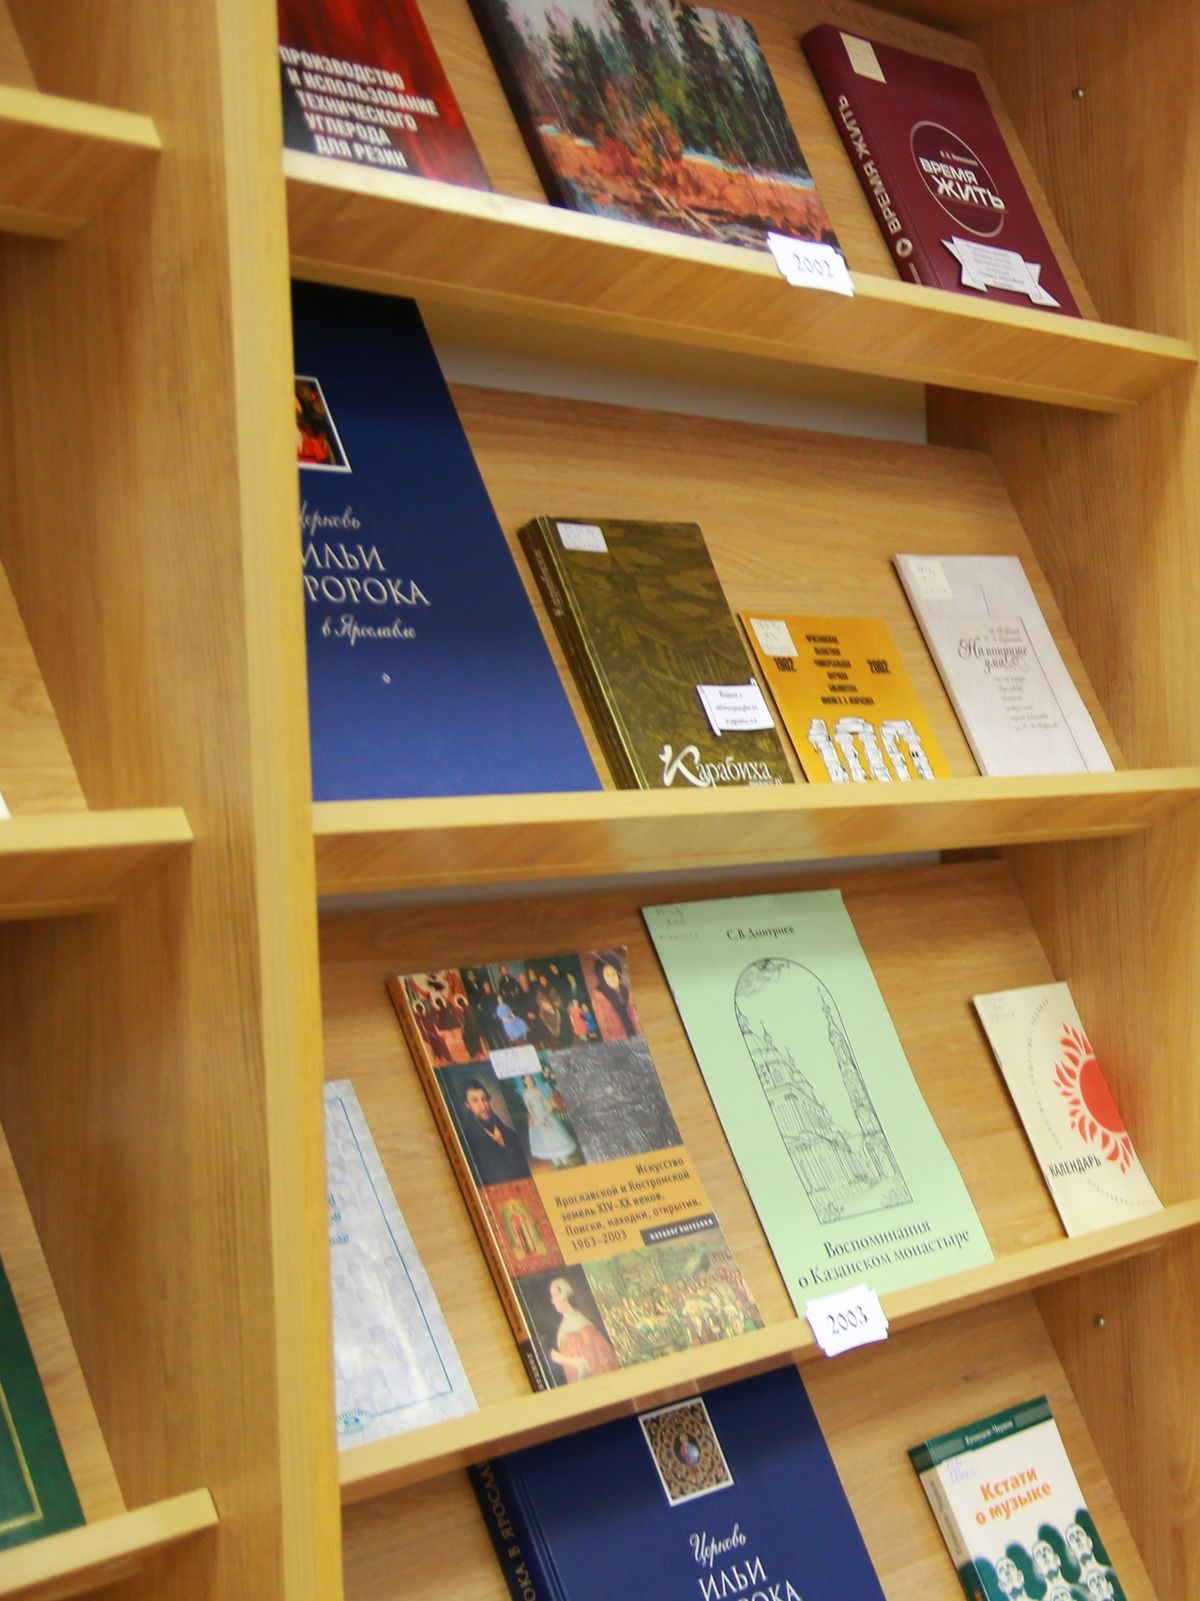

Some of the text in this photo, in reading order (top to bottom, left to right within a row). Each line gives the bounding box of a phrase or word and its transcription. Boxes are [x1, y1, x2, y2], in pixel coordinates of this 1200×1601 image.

[279, 45, 405, 90] ПРОИЗВОДСТВО
[287, 67, 440, 117] И ИСПОЛЬЗОВАНИЕ
[296, 89, 418, 132] ТЕХНИЧЕСКОГО
[838, 94, 870, 160] ЖИТЬ
[304, 112, 392, 146] УГЛЕРОДА
[314, 133, 408, 168] ДЛЯ РЕЗИН
[919, 157, 979, 185] ВРЕМЯ
[863, 160, 903, 235] ВРЕМЯ
[932, 175, 1006, 210] ЖИТЬ
[791, 252, 835, 278] 2002
[303, 574, 431, 606] РОРОКА
[659, 744, 772, 788] Карабиха
[635, 1157, 684, 1175] Искусство
[1048, 1154, 1102, 1179] КАЛЕНДАРЬ
[554, 1171, 690, 1208] Ярославской и Костромской
[561, 1207, 596, 1222] земель
[822, 1221, 931, 1259] Воспоминания
[798, 1230, 970, 1289] о Казанском монастыре
[827, 1305, 868, 1335] 2003
[980, 1468, 1038, 1501] Кстати
[975, 1482, 1052, 1525] о музыке
[699, 1556, 767, 1601] ИЛЬИ
